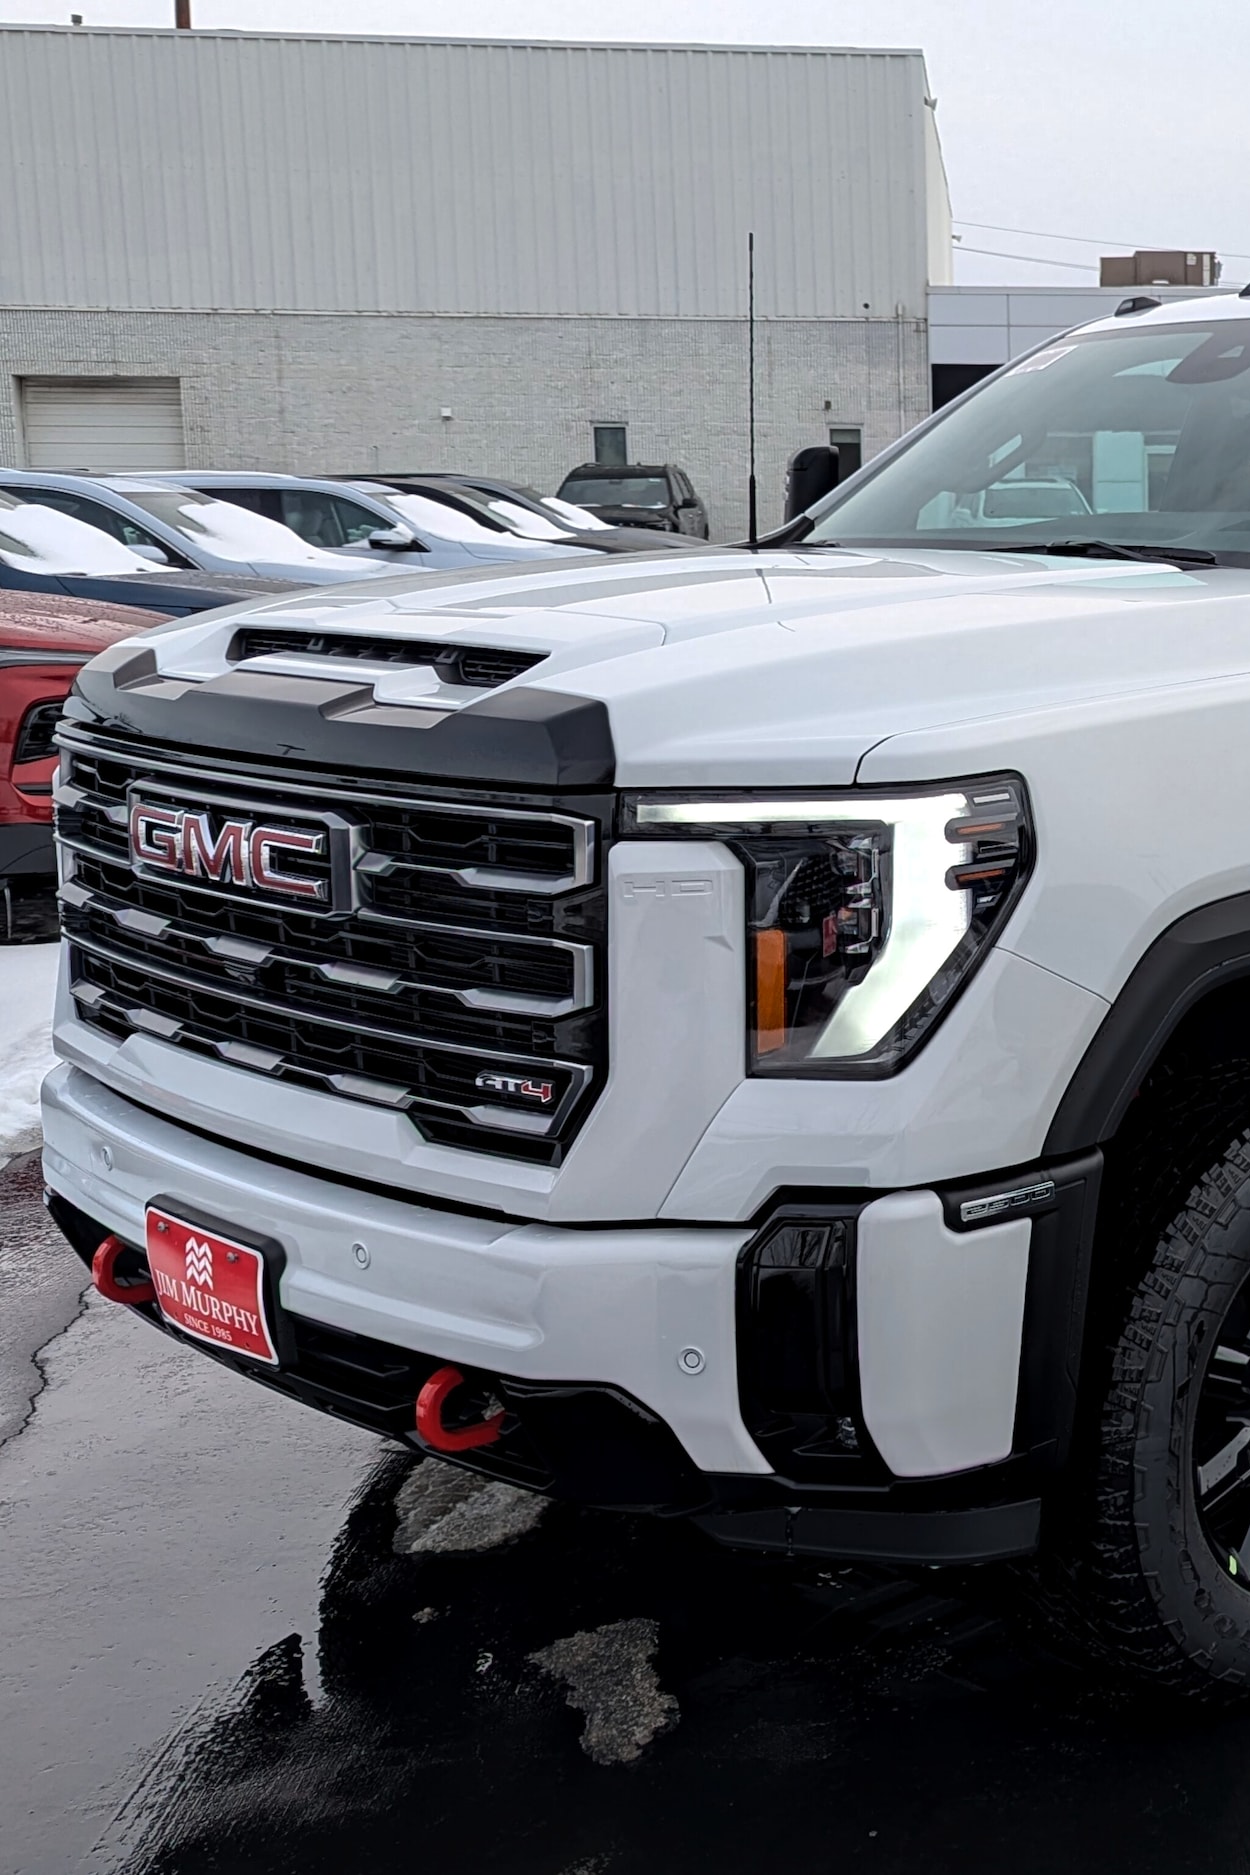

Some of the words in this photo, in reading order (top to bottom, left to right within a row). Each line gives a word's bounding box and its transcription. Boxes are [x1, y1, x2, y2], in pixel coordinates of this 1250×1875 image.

[130, 801, 328, 900] GMC
[624, 878, 713, 899] HD
[475, 1072, 553, 1103] AT4
[961, 1182, 1055, 1222] 2500
[155, 1268, 180, 1301] JIM
[180, 1280, 260, 1336] MURPHY
[183, 1313, 210, 1334] SINCE
[212, 1325, 232, 1341] 1985
